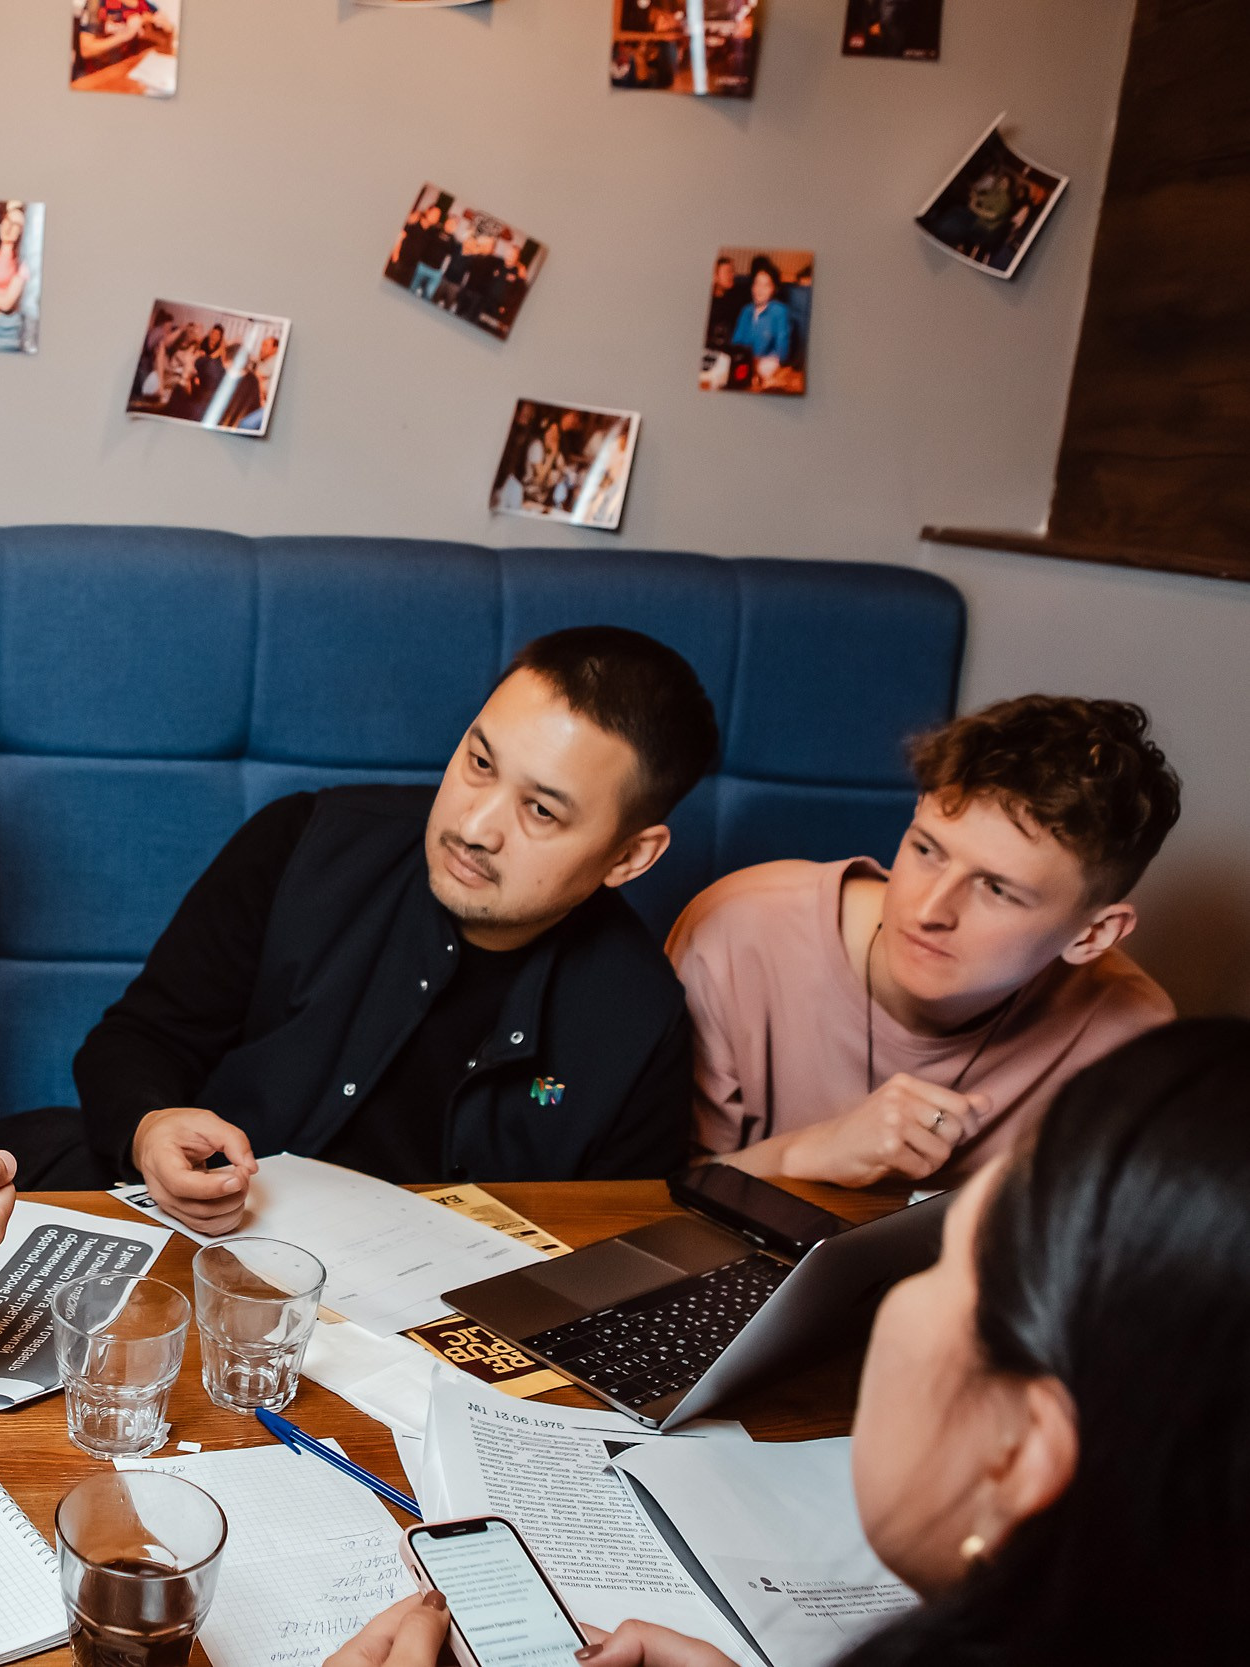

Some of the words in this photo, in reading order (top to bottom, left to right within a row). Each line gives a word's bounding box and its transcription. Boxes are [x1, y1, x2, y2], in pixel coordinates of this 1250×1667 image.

[25, 1229, 58, 1263] обратной
[34, 1233, 78, 1277] сбережения,
[59, 1238, 99, 1280] тыквенного
[104, 1241, 119, 1251] ты
[114, 1250, 134, 1270] день
[0, 1263, 32, 1294] стороне
[26, 1279, 44, 1293] мы
[0, 1309, 44, 1354] пересчитай
[8, 1331, 51, 1372] отведаешь
[495, 1410, 565, 1429] 13.06.1975
